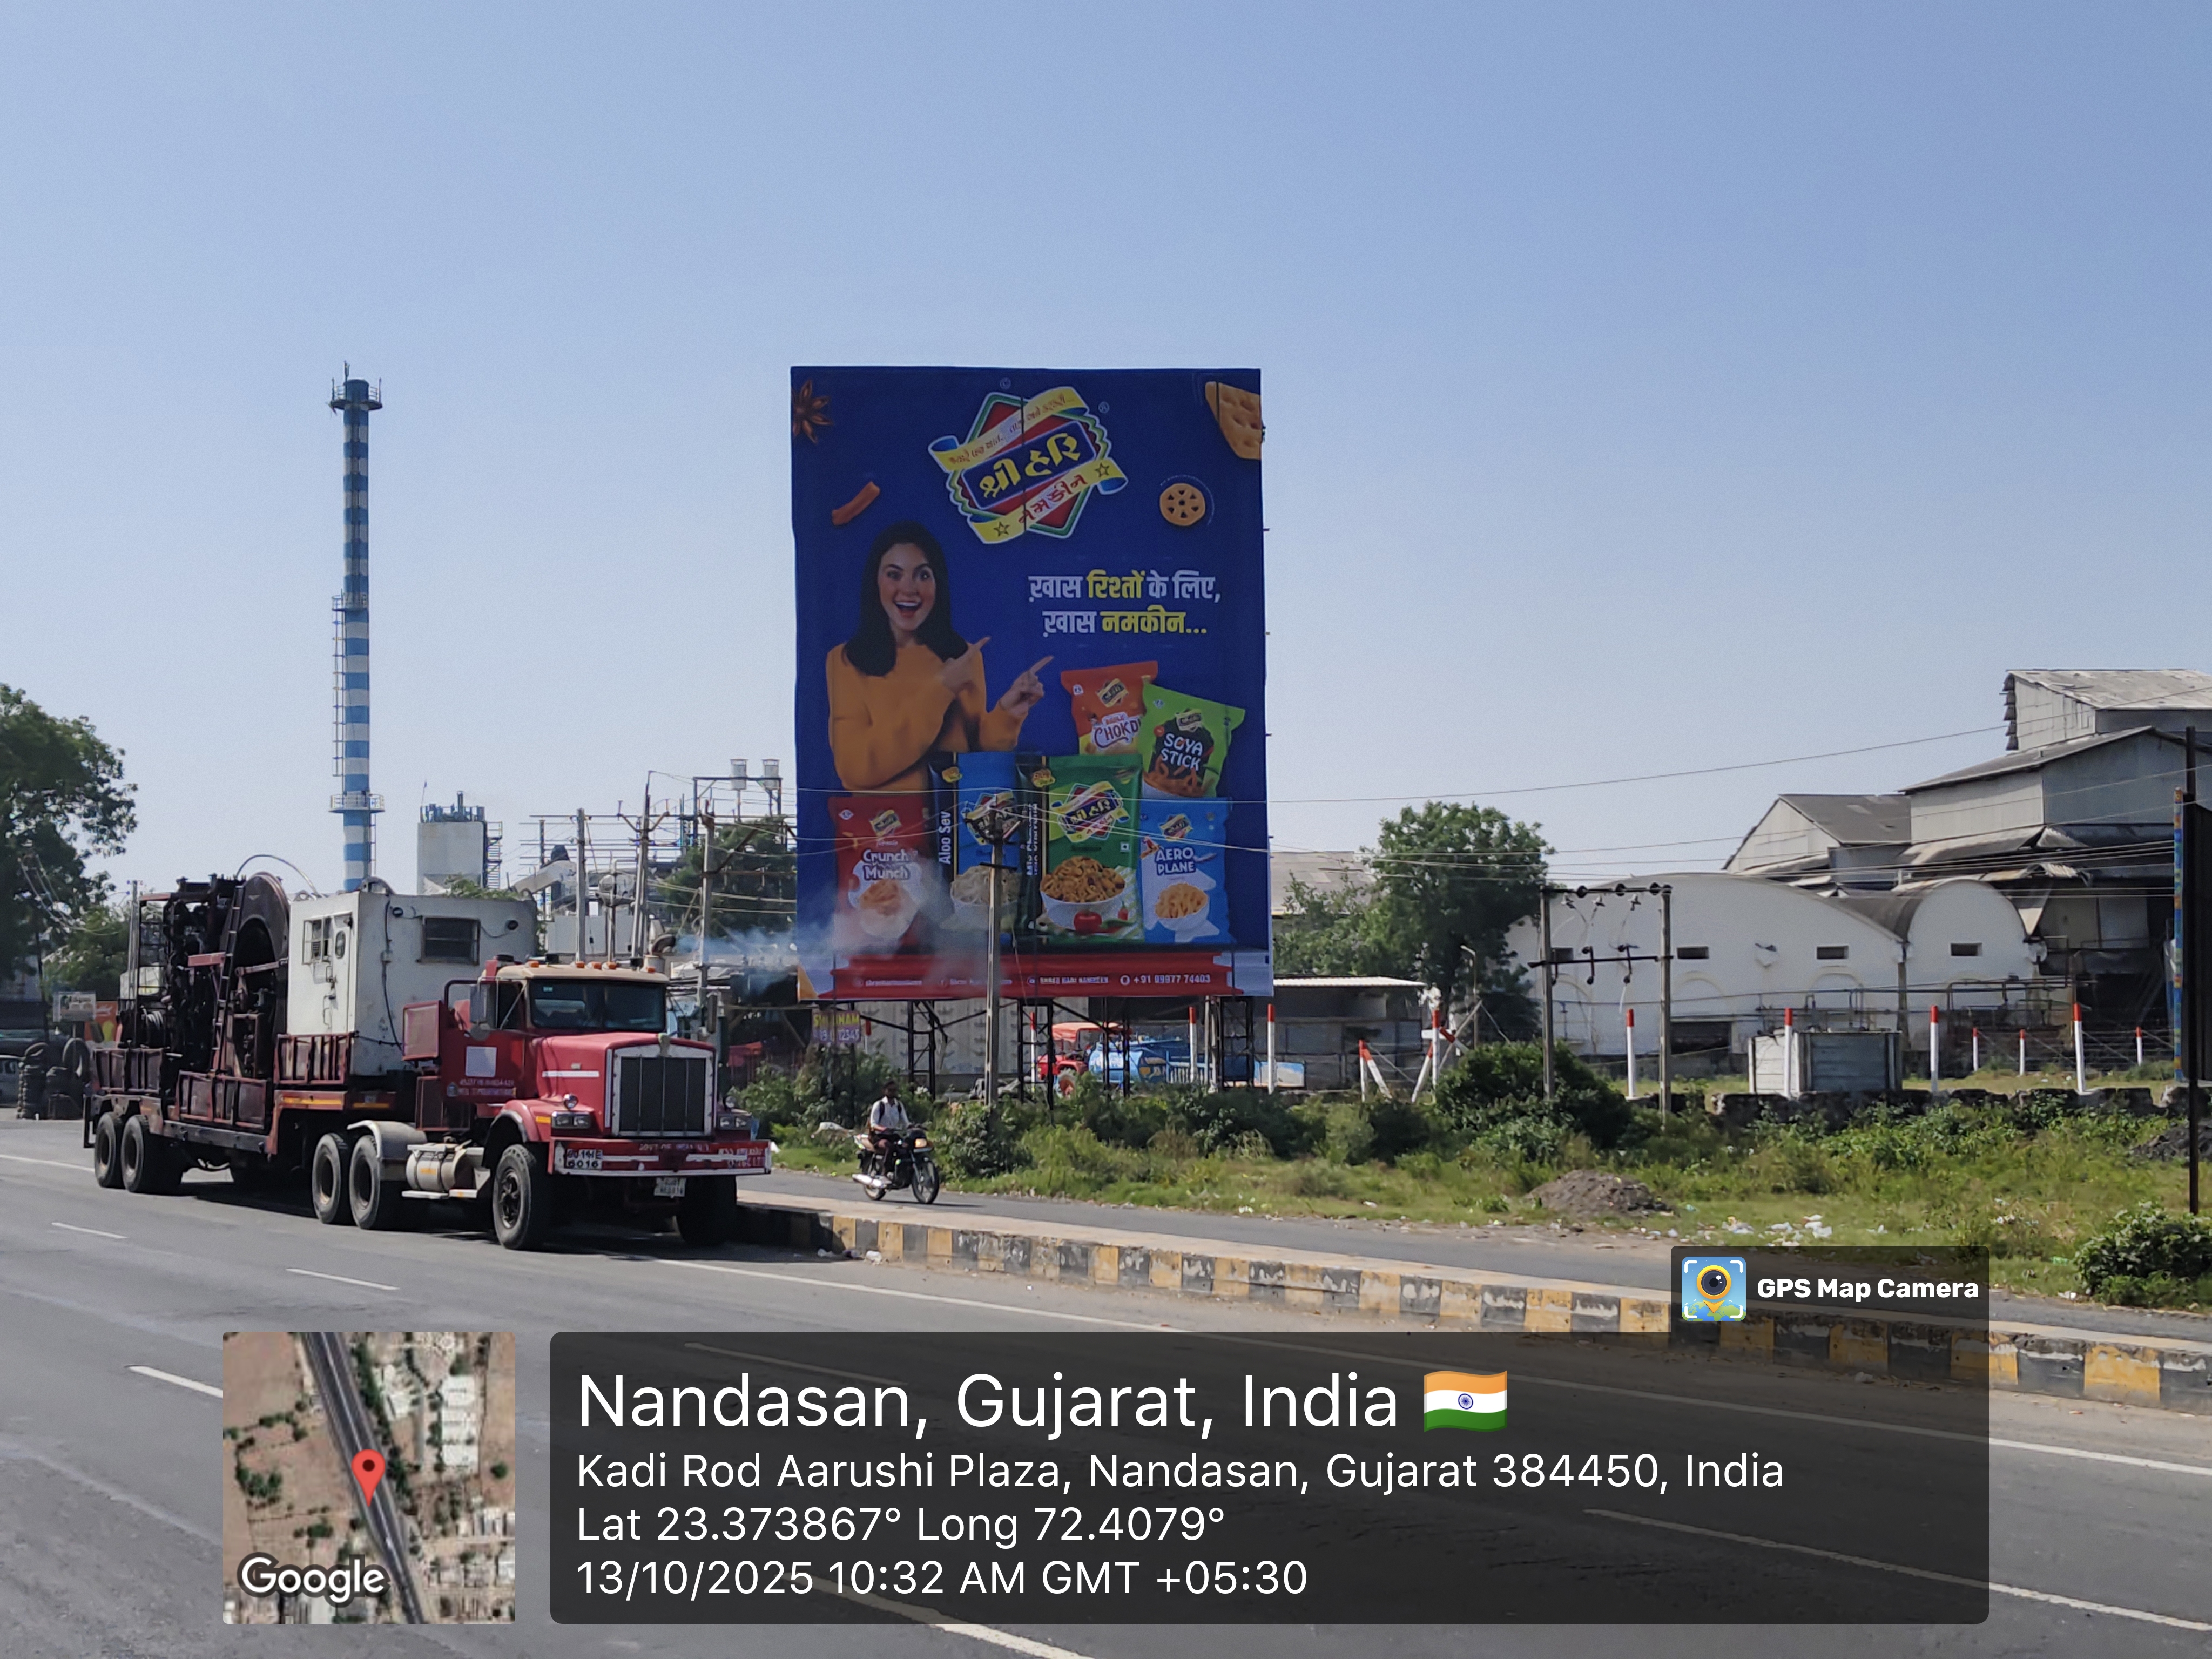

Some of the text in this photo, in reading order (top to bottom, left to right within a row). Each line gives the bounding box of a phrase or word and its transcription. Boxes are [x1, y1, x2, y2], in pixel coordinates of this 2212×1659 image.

[979, 458, 1021, 497] શ્રી
[1024, 433, 1080, 476] હરિ
[1028, 569, 1221, 603] ख़ास रिश्तों के लिए,
[1042, 605, 1207, 638] ख़ास नमकीन...
[1164, 733, 1203, 756] SOYA
[1161, 748, 1201, 771] STICK
[938, 811, 951, 865] Aloo Sev
[863, 849, 908, 862] Crunch
[1156, 847, 1194, 862] AERO
[865, 866, 909, 880] Munch
[1158, 861, 1195, 874] PLANE
